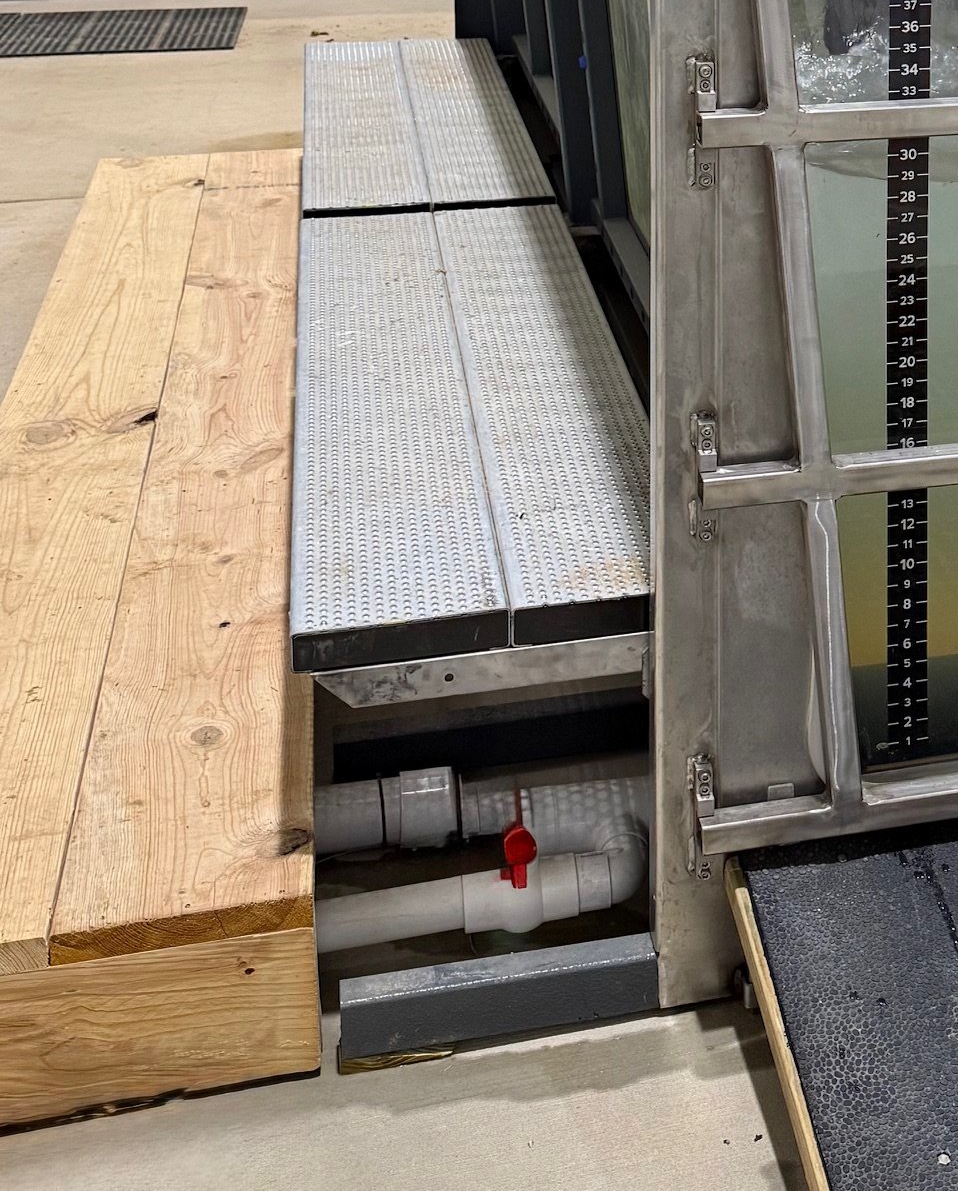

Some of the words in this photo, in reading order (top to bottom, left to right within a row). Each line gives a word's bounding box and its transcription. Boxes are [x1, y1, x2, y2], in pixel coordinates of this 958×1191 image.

[903, 0, 916, 10] 37
[901, 21, 918, 32] 36
[903, 44, 916, 53] 35
[901, 64, 917, 75] 34
[902, 86, 916, 96] 33
[899, 149, 916, 160] 30
[901, 171, 914, 180] 29
[899, 191, 915, 202] 28
[901, 213, 913, 222] 27
[899, 233, 915, 244] 26
[900, 254, 913, 264] 25
[898, 274, 914, 286] 24
[900, 296, 914, 305] 23
[899, 315, 915, 327] 22
[901, 337, 913, 346] 21
[898, 356, 915, 368] 20
[901, 378, 913, 387] 19
[900, 397, 914, 408] 18
[901, 418, 912, 427] 17
[900, 438, 914, 447] 16
[901, 499, 913, 508] 13
[900, 518, 914, 530] 12
[902, 539, 912, 548] 11
[899, 559, 914, 570] 10
[904, 580, 911, 589] 9
[903, 599, 912, 610] 8
[904, 619, 911, 629] 7
[903, 638, 911, 649] 6
[903, 659, 911, 668] 5
[904, 677, 911, 689] 4
[904, 698, 911, 707] 3
[903, 716, 912, 728] 2
[906, 737, 911, 746] 1
